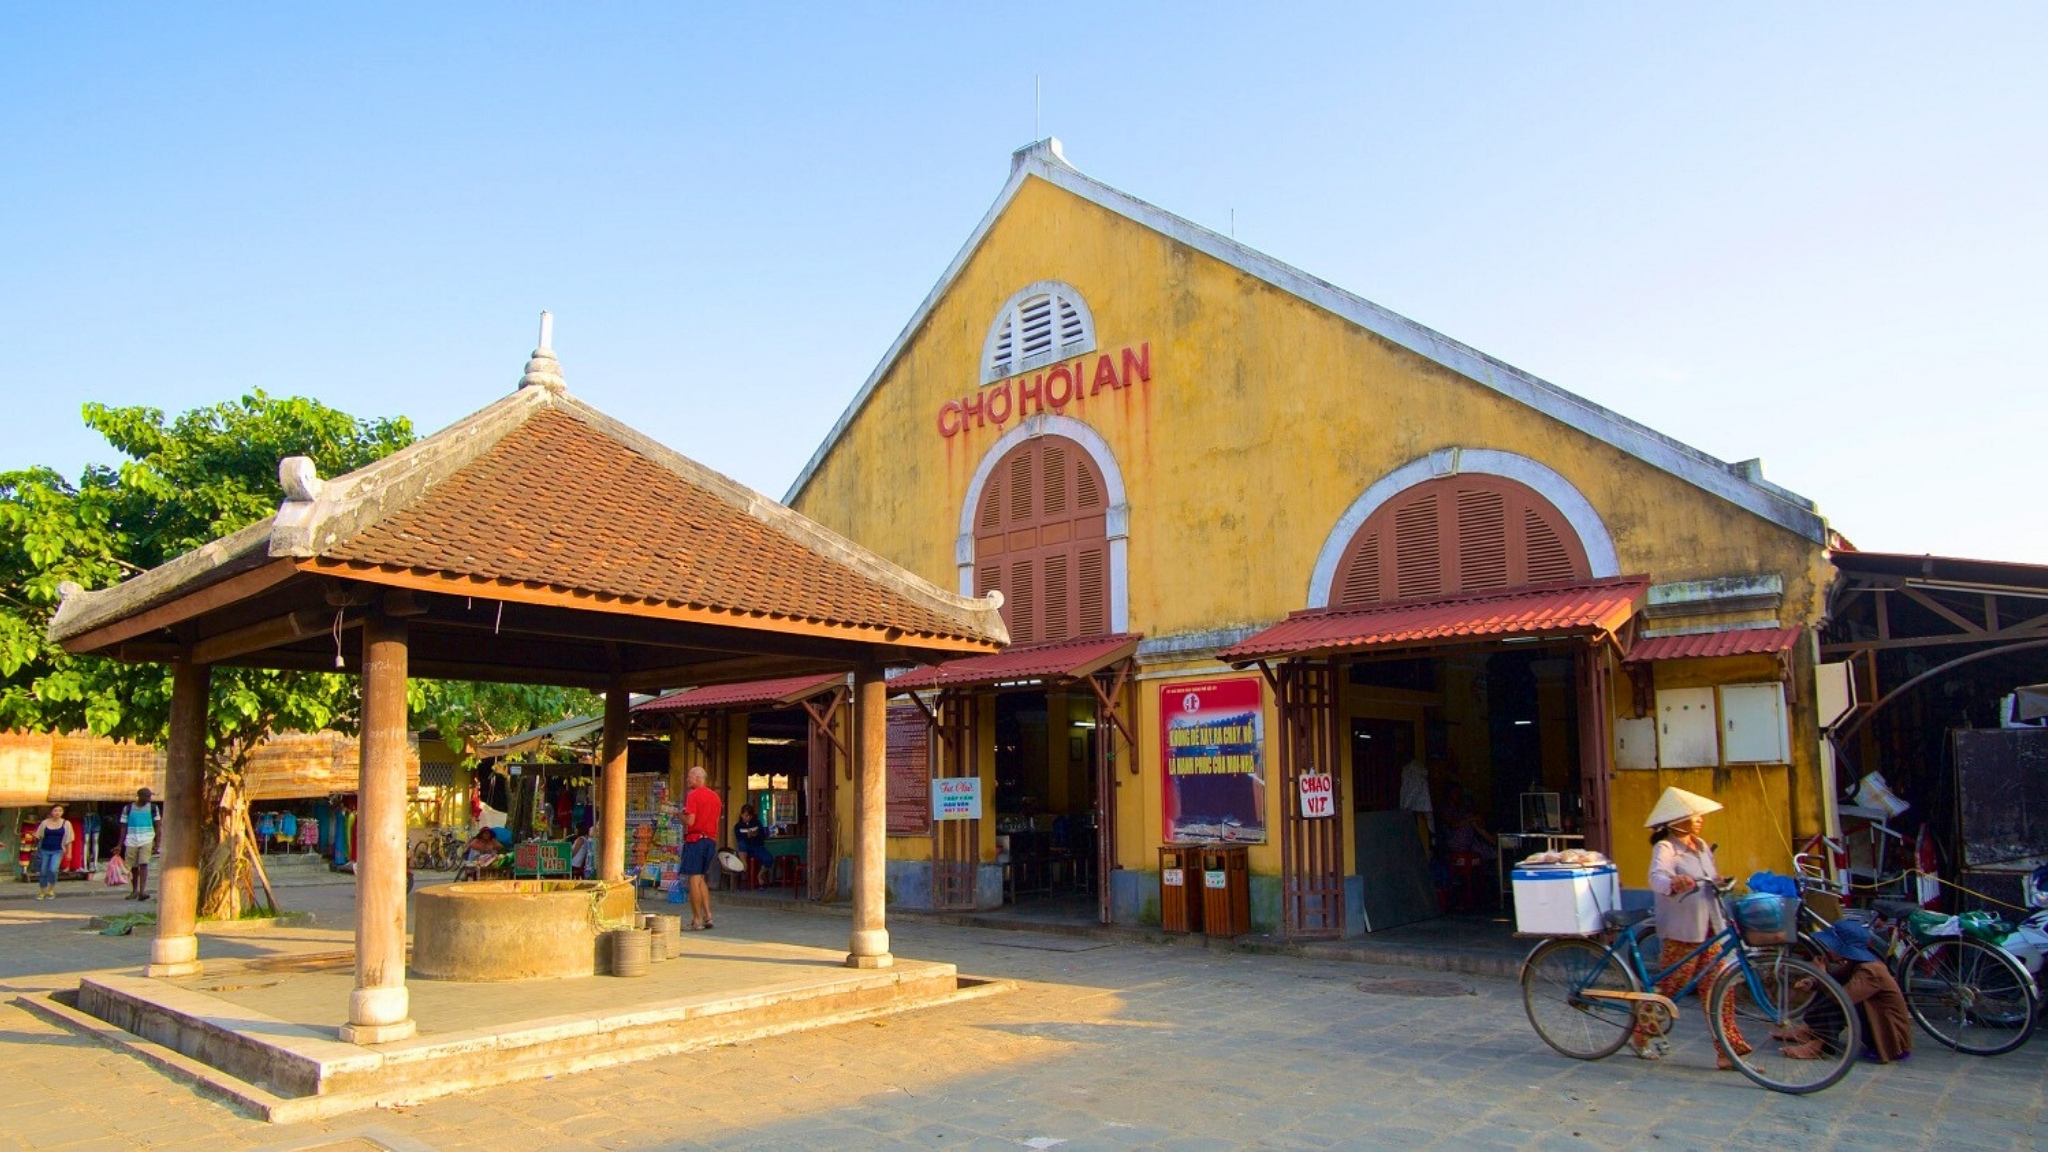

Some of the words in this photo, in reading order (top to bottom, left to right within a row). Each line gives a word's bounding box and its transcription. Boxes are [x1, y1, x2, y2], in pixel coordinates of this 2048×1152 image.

[937, 378, 1014, 437] CHỢ
[1018, 361, 1085, 415] HỘI
[1090, 341, 1151, 396] AN
